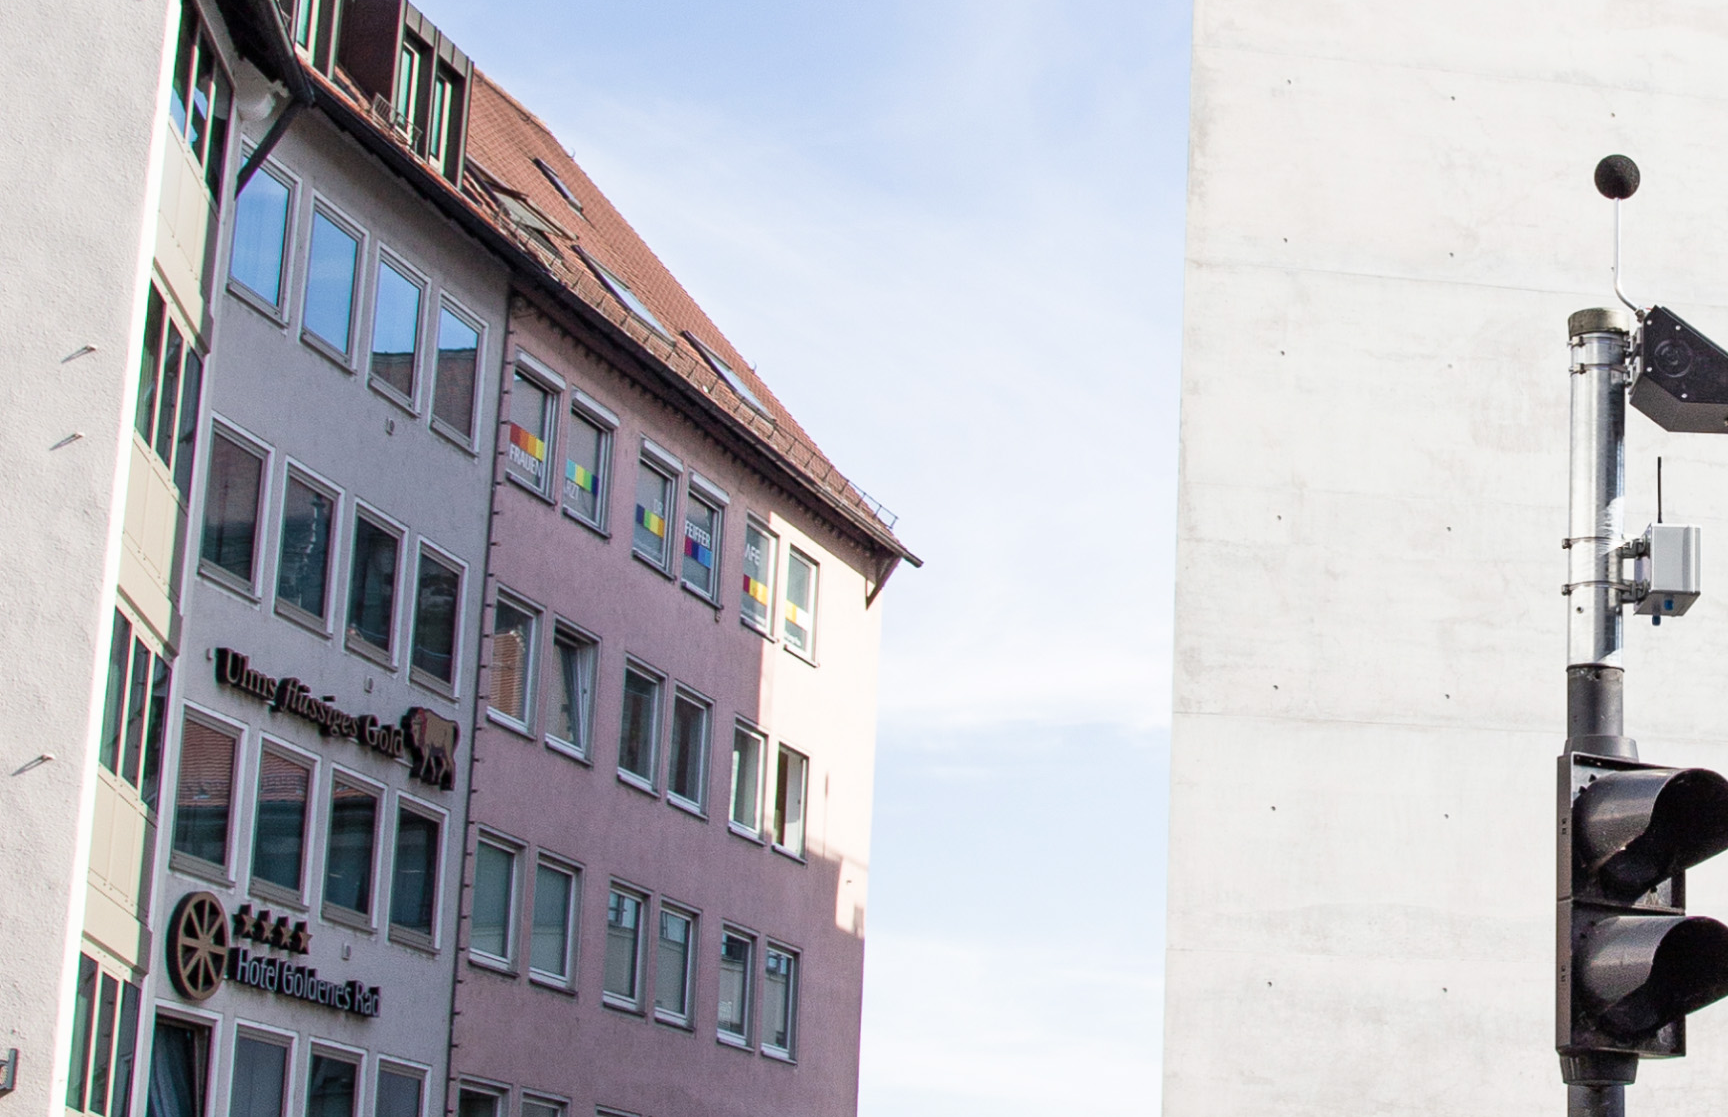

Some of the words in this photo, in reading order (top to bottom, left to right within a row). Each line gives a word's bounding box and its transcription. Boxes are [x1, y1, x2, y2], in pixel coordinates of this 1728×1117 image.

[509, 443, 543, 477] FRAUEN
[684, 520, 711, 549] FEIFFER
[222, 648, 278, 701] Ulms
[279, 678, 359, 737] flüssiges
[362, 715, 405, 759] Gold
[236, 947, 280, 993] Hotel
[282, 961, 352, 1011] Goldenes
[354, 980, 382, 1018] Rad
